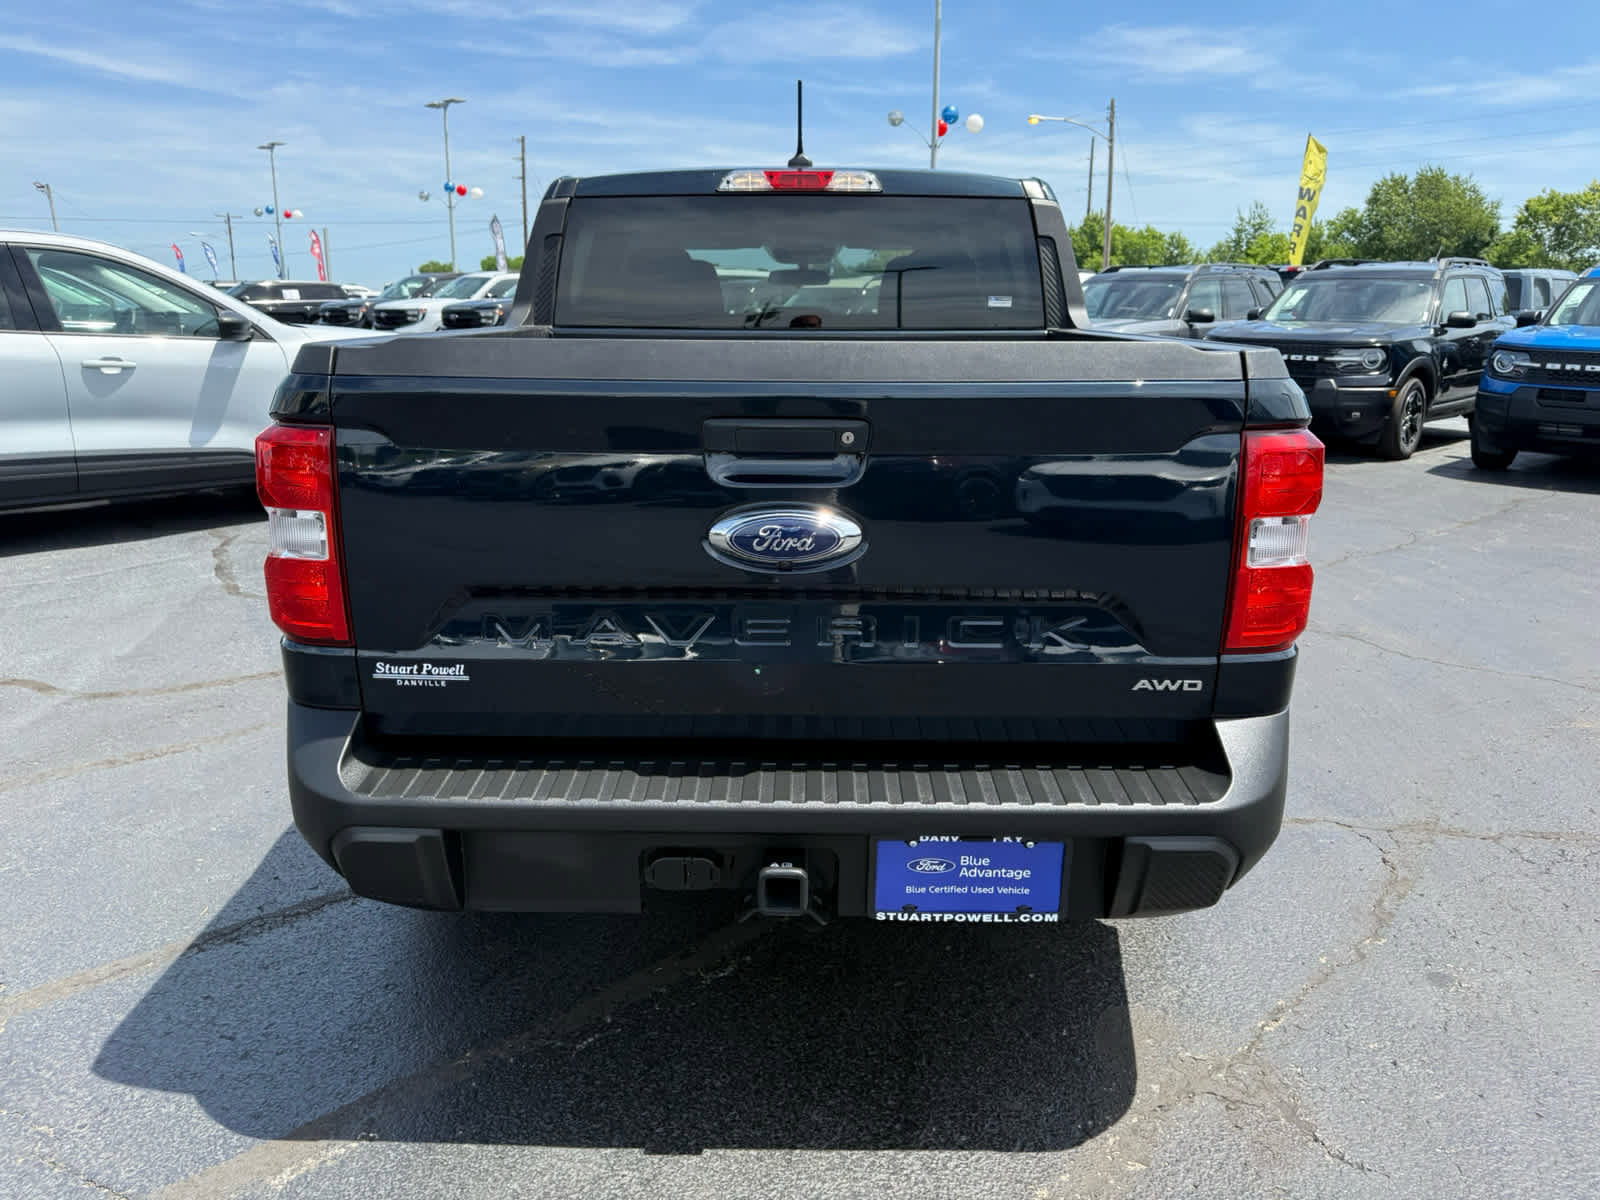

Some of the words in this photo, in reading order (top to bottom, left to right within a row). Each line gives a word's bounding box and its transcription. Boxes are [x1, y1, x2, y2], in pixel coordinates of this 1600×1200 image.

[753, 524, 817, 551] Ford
[480, 614, 1089, 650] MAVERICK
[375, 662, 418, 674] Stuart
[421, 663, 465, 676] Powell
[396, 679, 447, 687] DANVILLE
[1131, 679, 1203, 691] AWD
[915, 859, 946, 872] Ford
[960, 855, 990, 866] Blue
[959, 867, 1031, 880] Advantage
[905, 885, 926, 894] Blue
[928, 885, 968, 894] Certified
[970, 886, 994, 895] Used
[997, 886, 1030, 896] Vehicle
[875, 911, 1059, 923] STUARTPOWELL.COM
